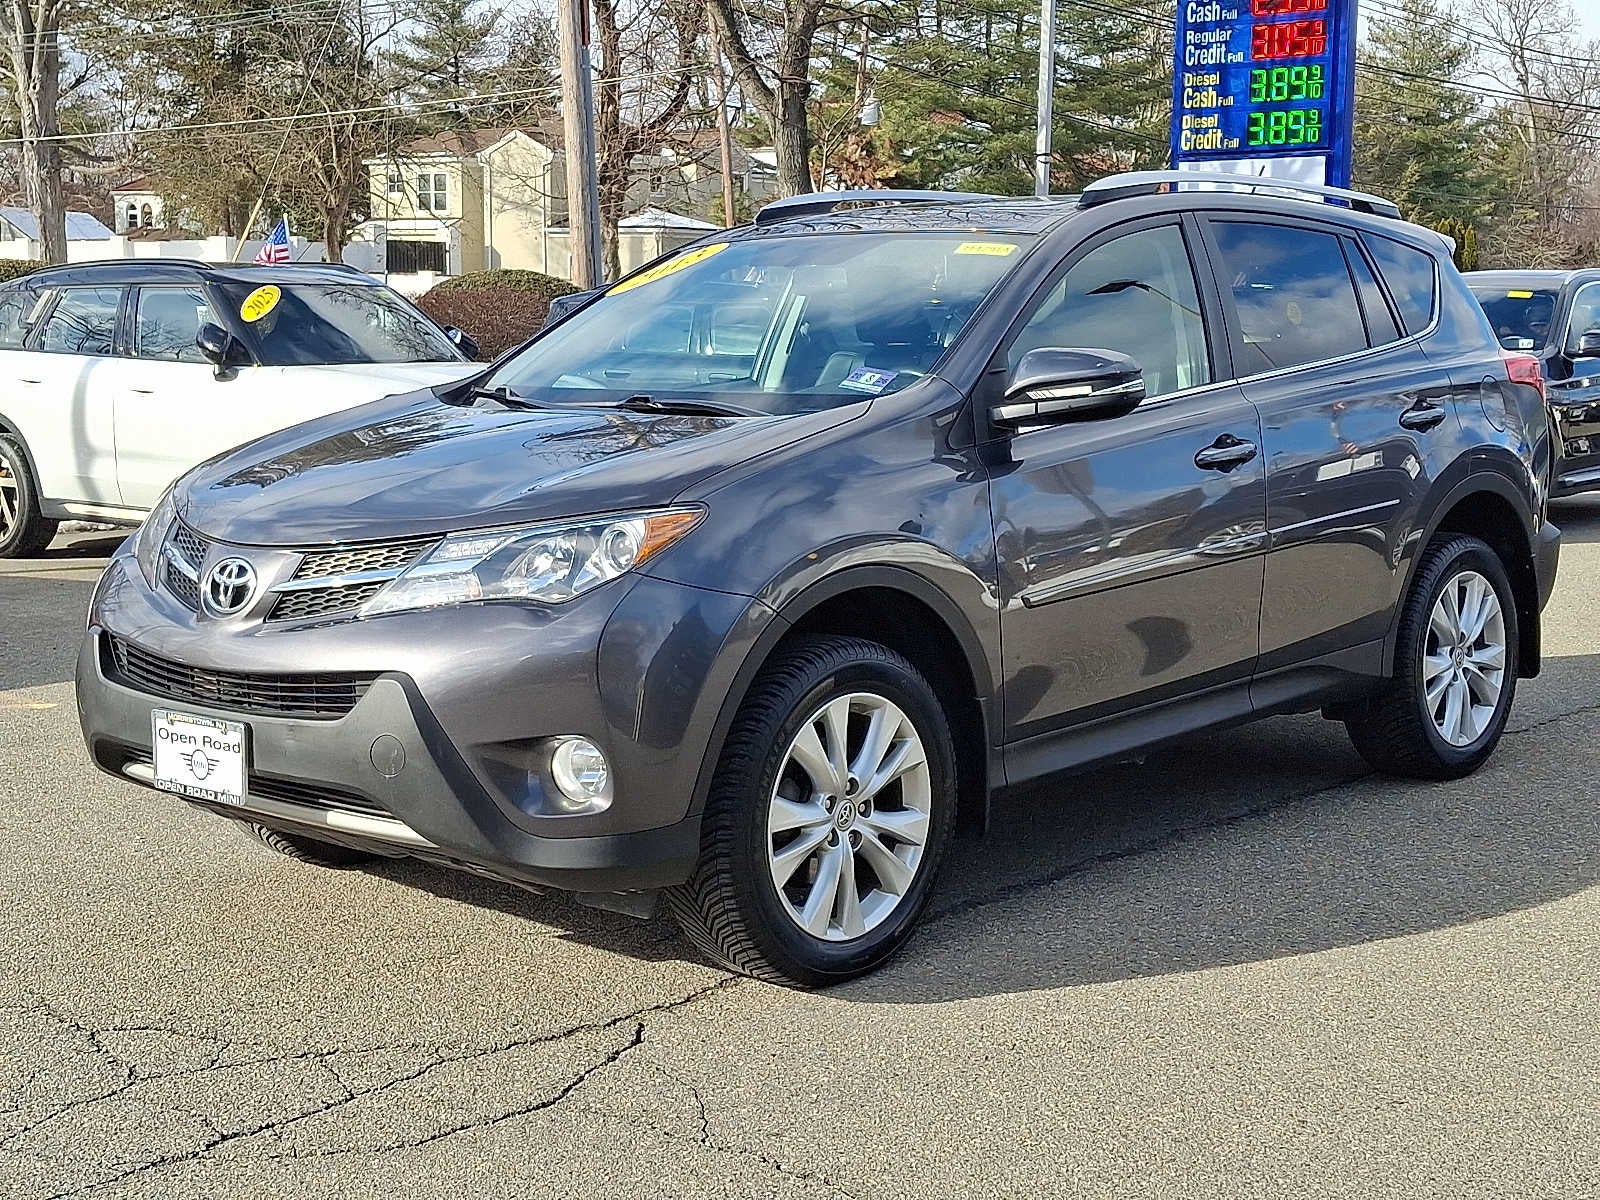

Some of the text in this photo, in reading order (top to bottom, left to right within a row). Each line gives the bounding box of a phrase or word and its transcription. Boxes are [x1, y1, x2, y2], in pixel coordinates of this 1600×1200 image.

[1187, 1, 1237, 23] Cash Full
[1186, 28, 1232, 45] Regular
[1185, 43, 1243, 66] Credit Full
[1184, 71, 1219, 86] Diesel
[1250, 66, 1307, 103] 3.89
[1183, 87, 1233, 108] Cash Full
[1182, 114, 1218, 129] Diesel
[1248, 110, 1304, 145] 3.89
[1181, 128, 1239, 151] Credit Full
[247, 288, 274, 316] 2025
[158, 727, 241, 754] Open Road
[157, 779, 240, 805] OPEN ROAD MINI
